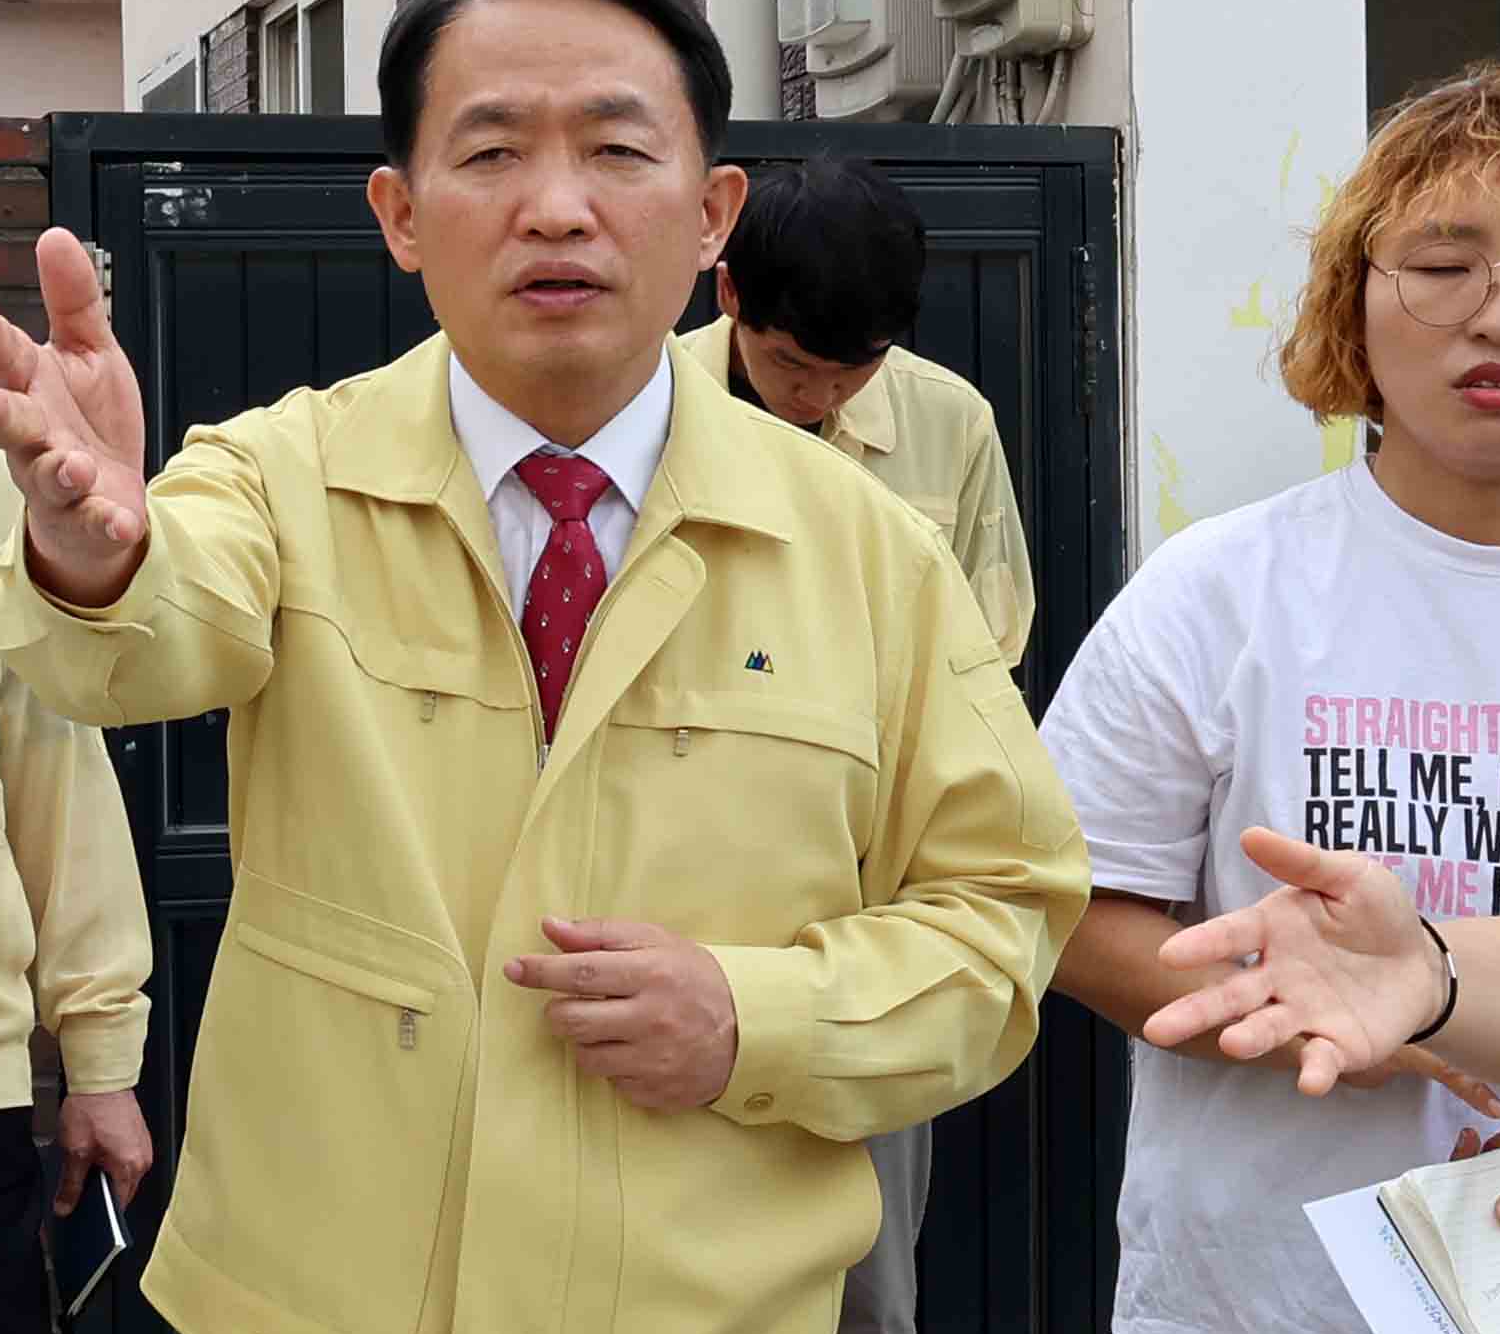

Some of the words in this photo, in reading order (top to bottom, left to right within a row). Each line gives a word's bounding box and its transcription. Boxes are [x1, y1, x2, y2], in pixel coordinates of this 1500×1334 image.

[1304, 747, 1396, 798] TELL
[1305, 800, 1449, 857] REALLY
[1415, 859, 1480, 917] ME
